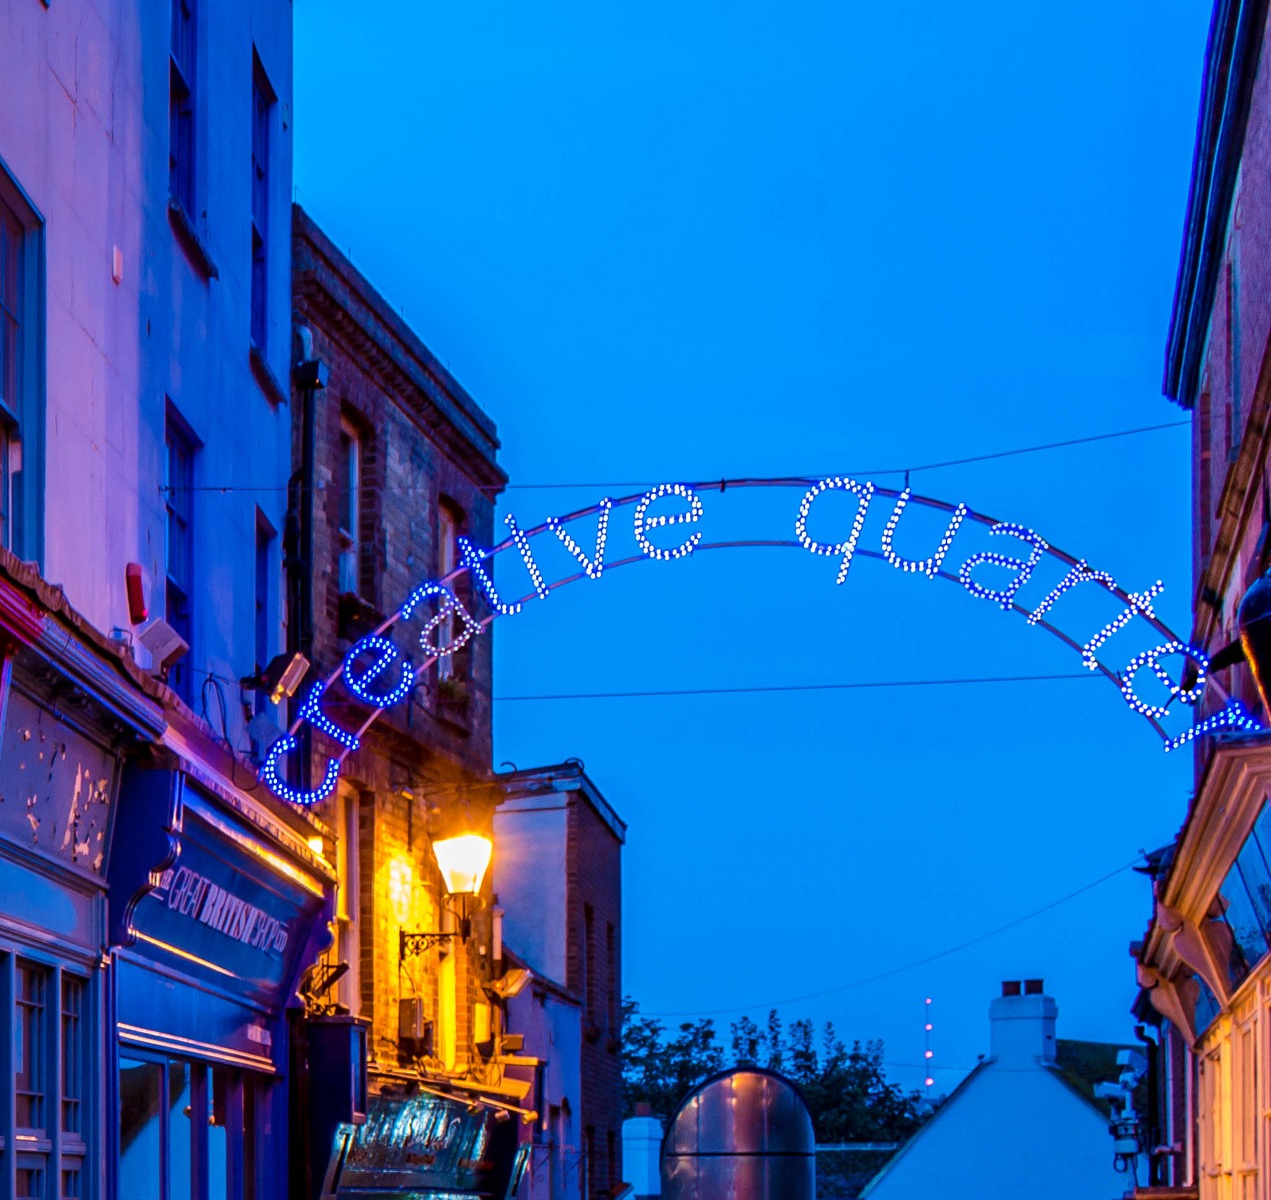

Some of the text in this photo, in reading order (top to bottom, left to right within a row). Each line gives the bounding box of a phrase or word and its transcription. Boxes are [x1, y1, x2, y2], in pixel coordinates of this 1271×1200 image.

[261, 476, 1263, 805] creative quarter
[168, 866, 211, 920] GREAT
[199, 882, 258, 945] BRITISH
[251, 908, 281, 952] SHOP
